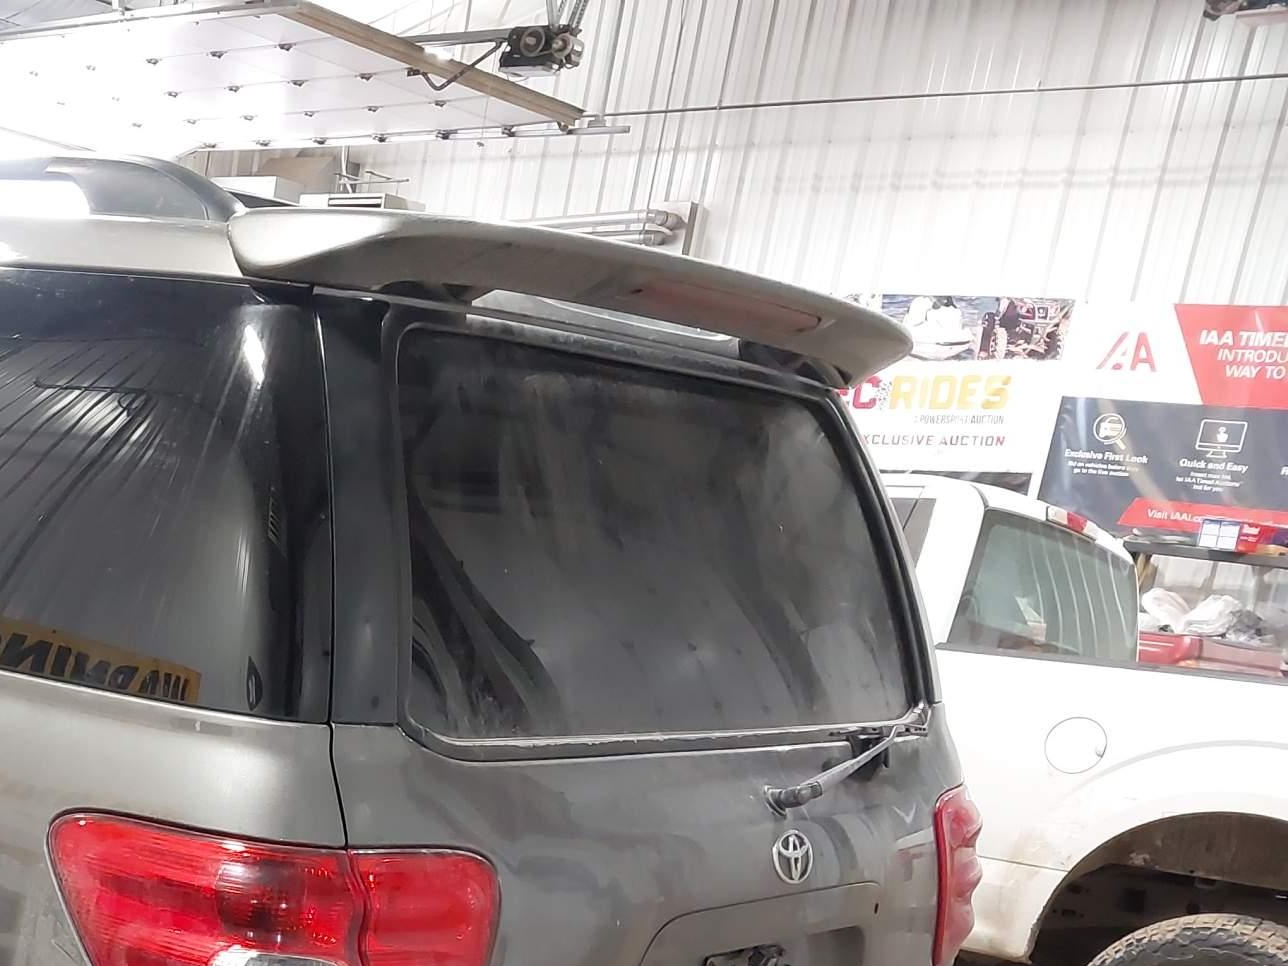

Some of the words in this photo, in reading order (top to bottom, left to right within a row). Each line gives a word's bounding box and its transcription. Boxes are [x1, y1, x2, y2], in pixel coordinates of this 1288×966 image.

[1199, 329, 1234, 346] IAA
[1225, 365, 1260, 379] WAY
[1266, 366, 1287, 380] TO
[889, 374, 1012, 411] RIDES
[938, 435, 1006, 447] AUCTION
[1064, 448, 1103, 460] Exclusive
[1104, 451, 1124, 462] First
[1125, 454, 1148, 464] Look
[1179, 458, 1207, 469] Quick
[1207, 462, 1225, 470] and
[1226, 462, 1248, 474] Easy
[1147, 508, 1168, 519] Visit
